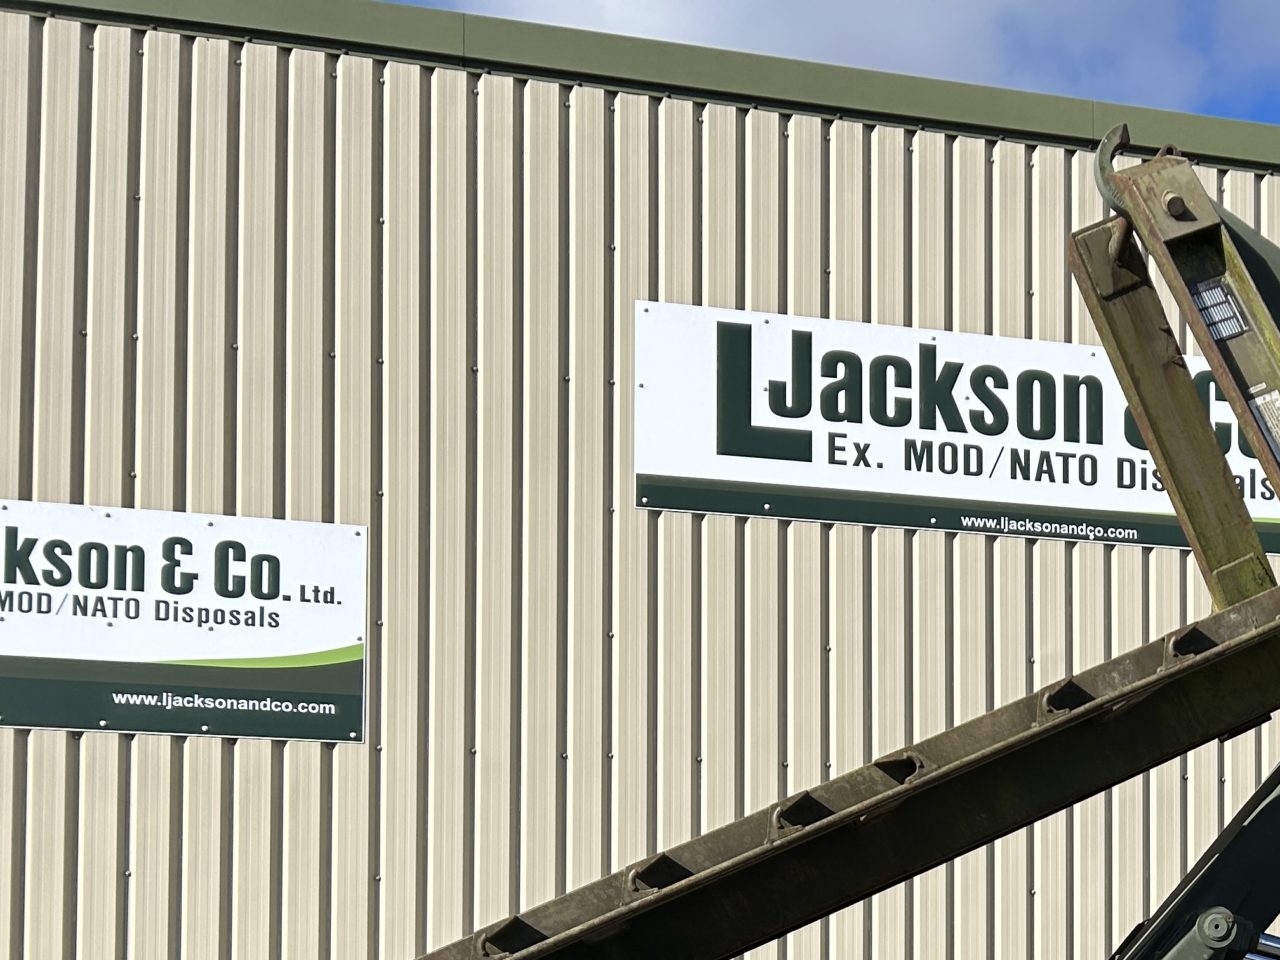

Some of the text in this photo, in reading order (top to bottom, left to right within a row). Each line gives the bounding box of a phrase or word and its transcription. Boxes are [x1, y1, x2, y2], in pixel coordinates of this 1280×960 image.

[827, 432, 884, 468] Ex.
[904, 439, 1098, 486] MOD/NATO
[960, 516, 1138, 539] www.ljacksonandco.com
[161, 536, 199, 595] &
[214, 540, 292, 602] Co.
[299, 584, 342, 605] Ltd.
[154, 599, 280, 628] Disposals
[112, 691, 336, 714] www.ljacksonandco.com
